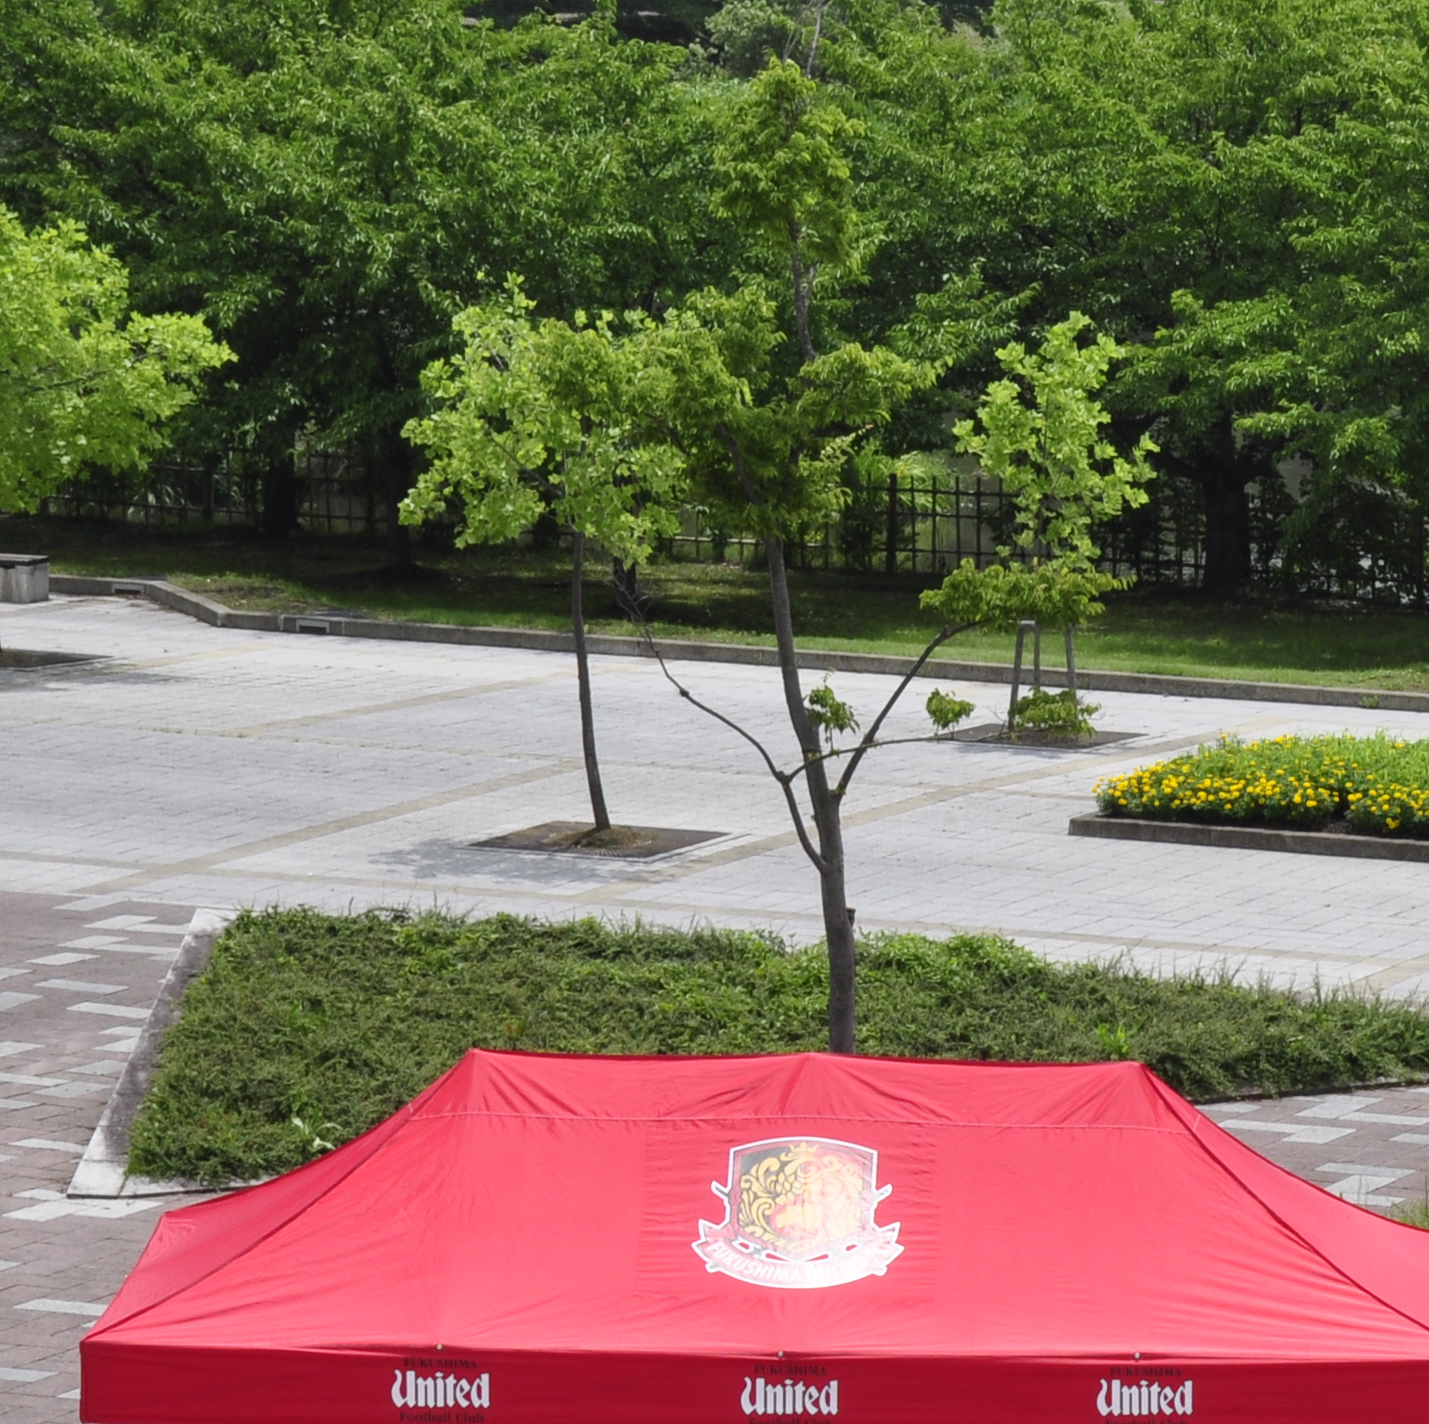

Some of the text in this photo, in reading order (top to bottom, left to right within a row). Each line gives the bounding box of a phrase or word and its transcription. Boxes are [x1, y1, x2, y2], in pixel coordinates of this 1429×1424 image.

[707, 1241, 801, 1282] FUKUSHIMA
[391, 1369, 490, 1409] United
[740, 1376, 839, 1416] United
[1096, 1378, 1194, 1417] United
[400, 1410, 485, 1424] Football Club
